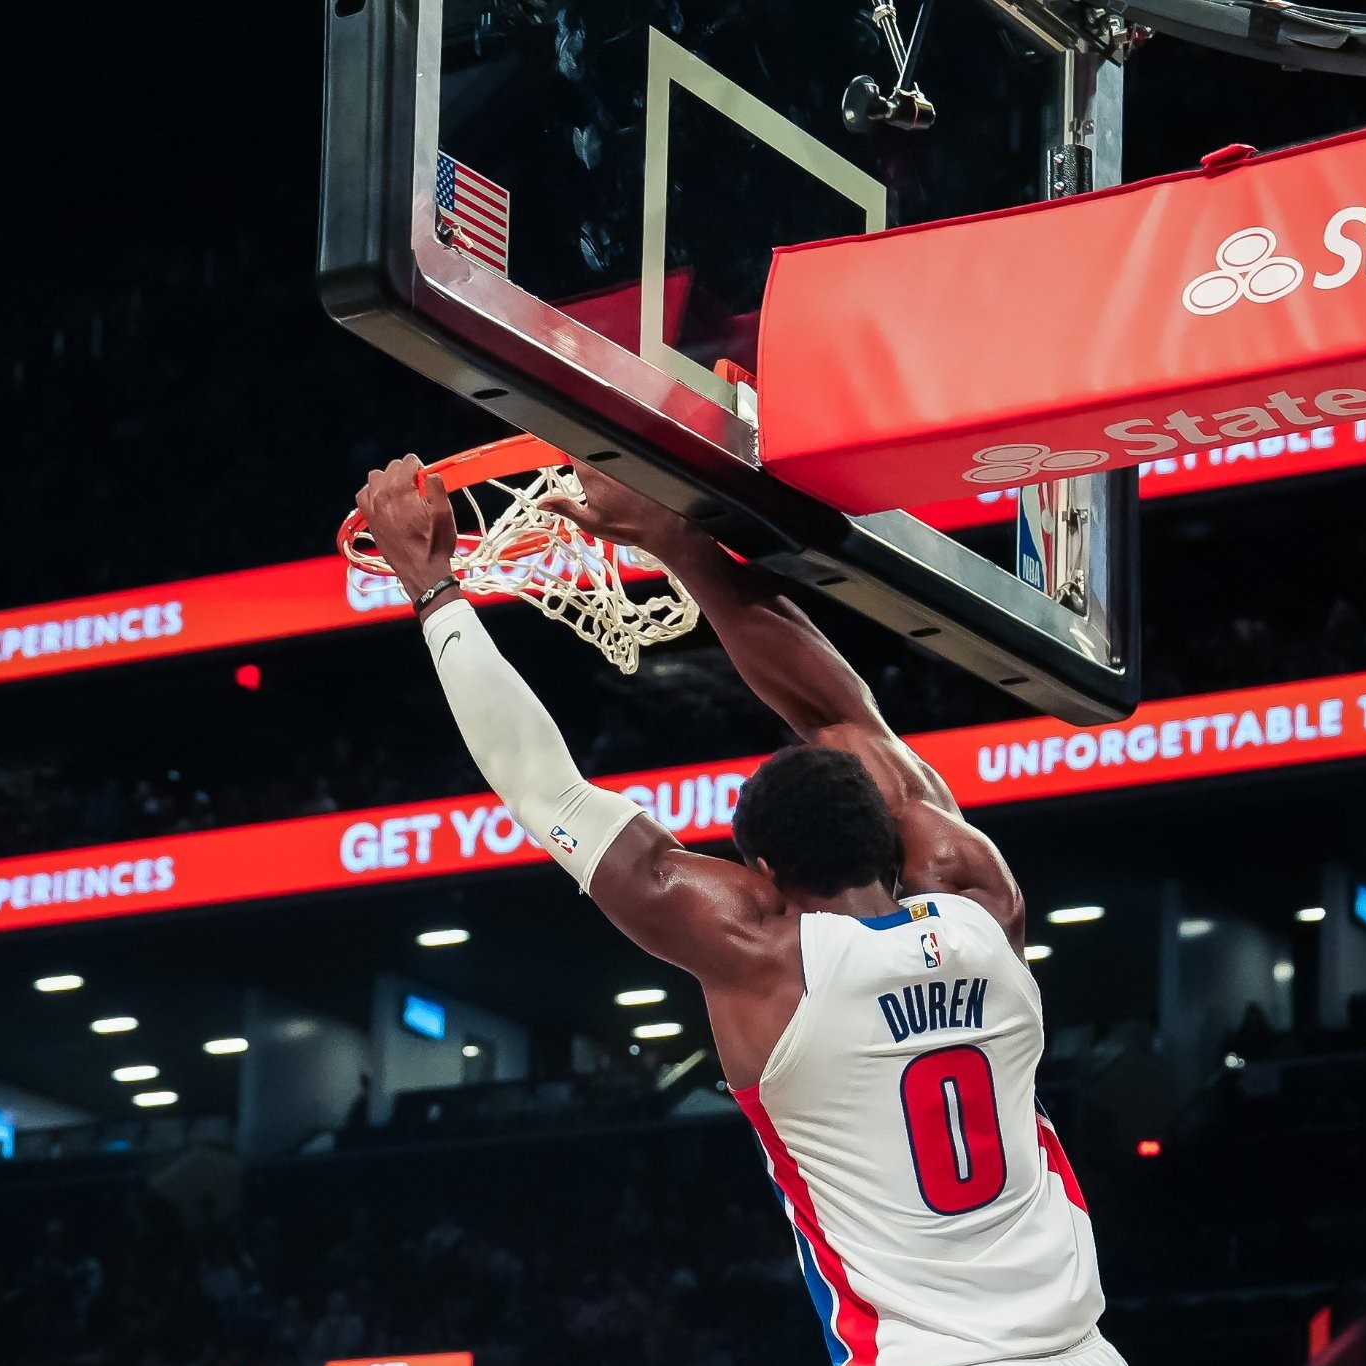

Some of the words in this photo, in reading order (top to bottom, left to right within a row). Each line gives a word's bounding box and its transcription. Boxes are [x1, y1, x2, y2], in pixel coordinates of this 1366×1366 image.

[1022, 553, 1041, 588] NBA
[978, 698, 1343, 782] UNFORGETTABLE
[340, 813, 441, 874] GET
[877, 977, 989, 1044] DUREN
[899, 1043, 1008, 1217] 0
